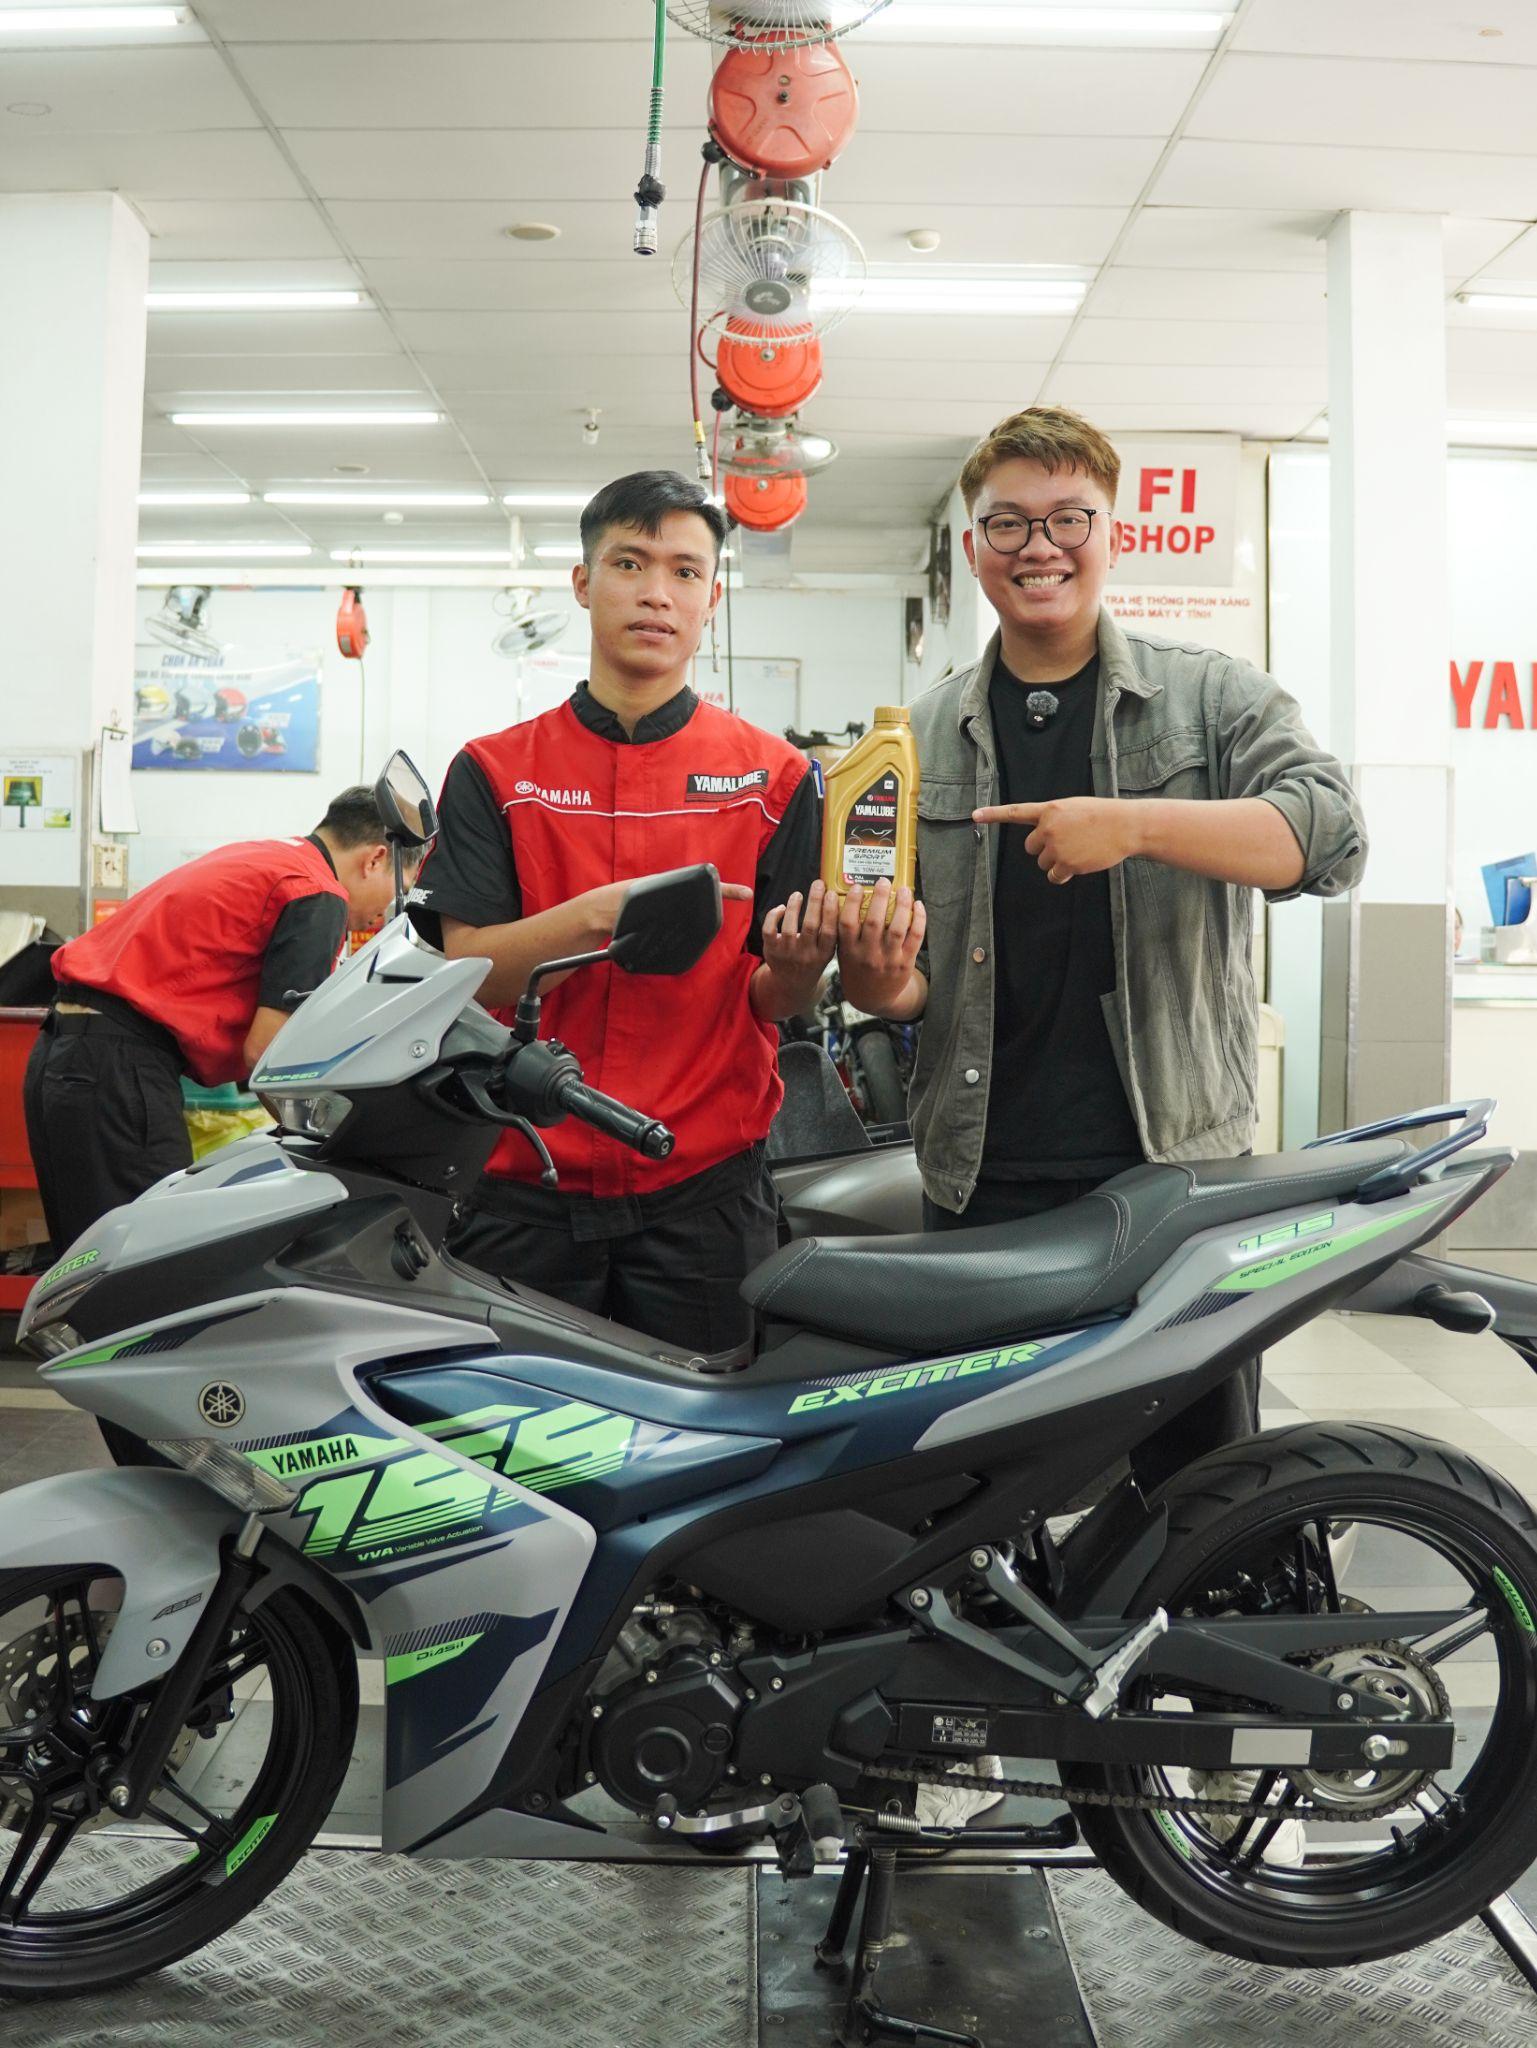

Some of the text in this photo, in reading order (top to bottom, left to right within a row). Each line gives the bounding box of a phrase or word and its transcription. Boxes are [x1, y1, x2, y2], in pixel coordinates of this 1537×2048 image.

[1139, 468, 1196, 513] FI
[1121, 524, 1215, 554] SHOP
[1449, 660, 1537, 730] YA
[534, 783, 592, 806] YAMAHA
[694, 771, 763, 793] YAMALUBE
[855, 804, 896, 818] YAMALUBE
[848, 847, 892, 855] PREMIUM
[1239, 1240, 1334, 1279] SPECIAL EDITION
[787, 1342, 1046, 1415] EXCITER
[271, 1437, 360, 1476] YAMAHA
[357, 1525, 484, 1561] VVA Variable Valve Actuation
[230, 1821, 271, 1871] EXCITER
